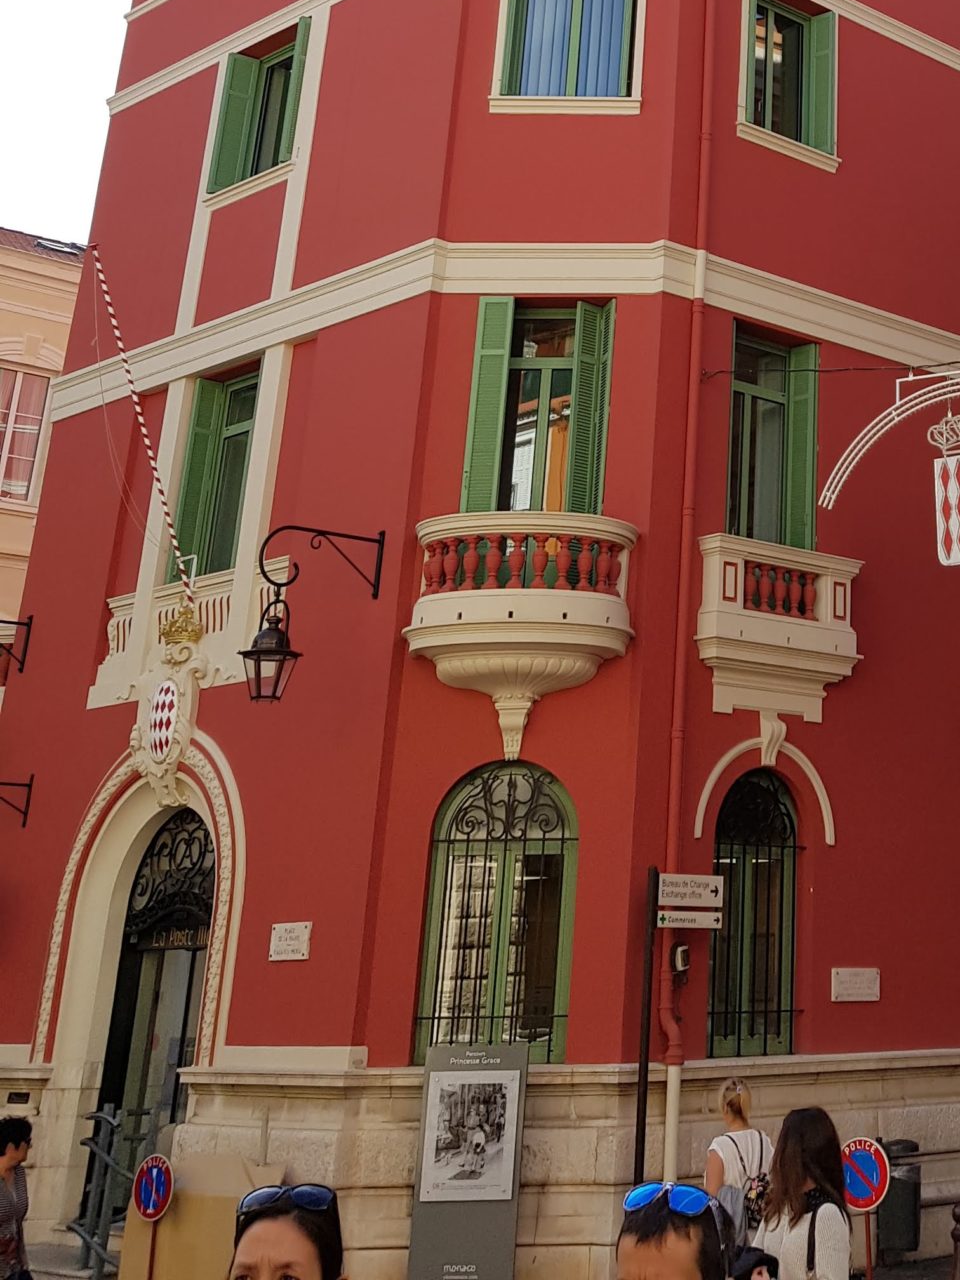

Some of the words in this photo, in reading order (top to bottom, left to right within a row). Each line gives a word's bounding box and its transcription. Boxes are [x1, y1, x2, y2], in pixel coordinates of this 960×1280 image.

[662, 879, 681, 888] Bureau
[682, 880, 688, 888] de
[690, 880, 710, 891] Change
[661, 889, 687, 900] Exchange
[689, 891, 702, 899] office
[668, 916, 696, 924] Commerces
[152, 930, 166, 946] La
[169, 927, 194, 946] Poste
[450, 1057, 480, 1065] Princesse
[481, 1056, 500, 1064] Grace
[844, 1140, 877, 1156] POLICE
[143, 1157, 168, 1171] POLICE
[443, 1264, 476, 1272] monaco
